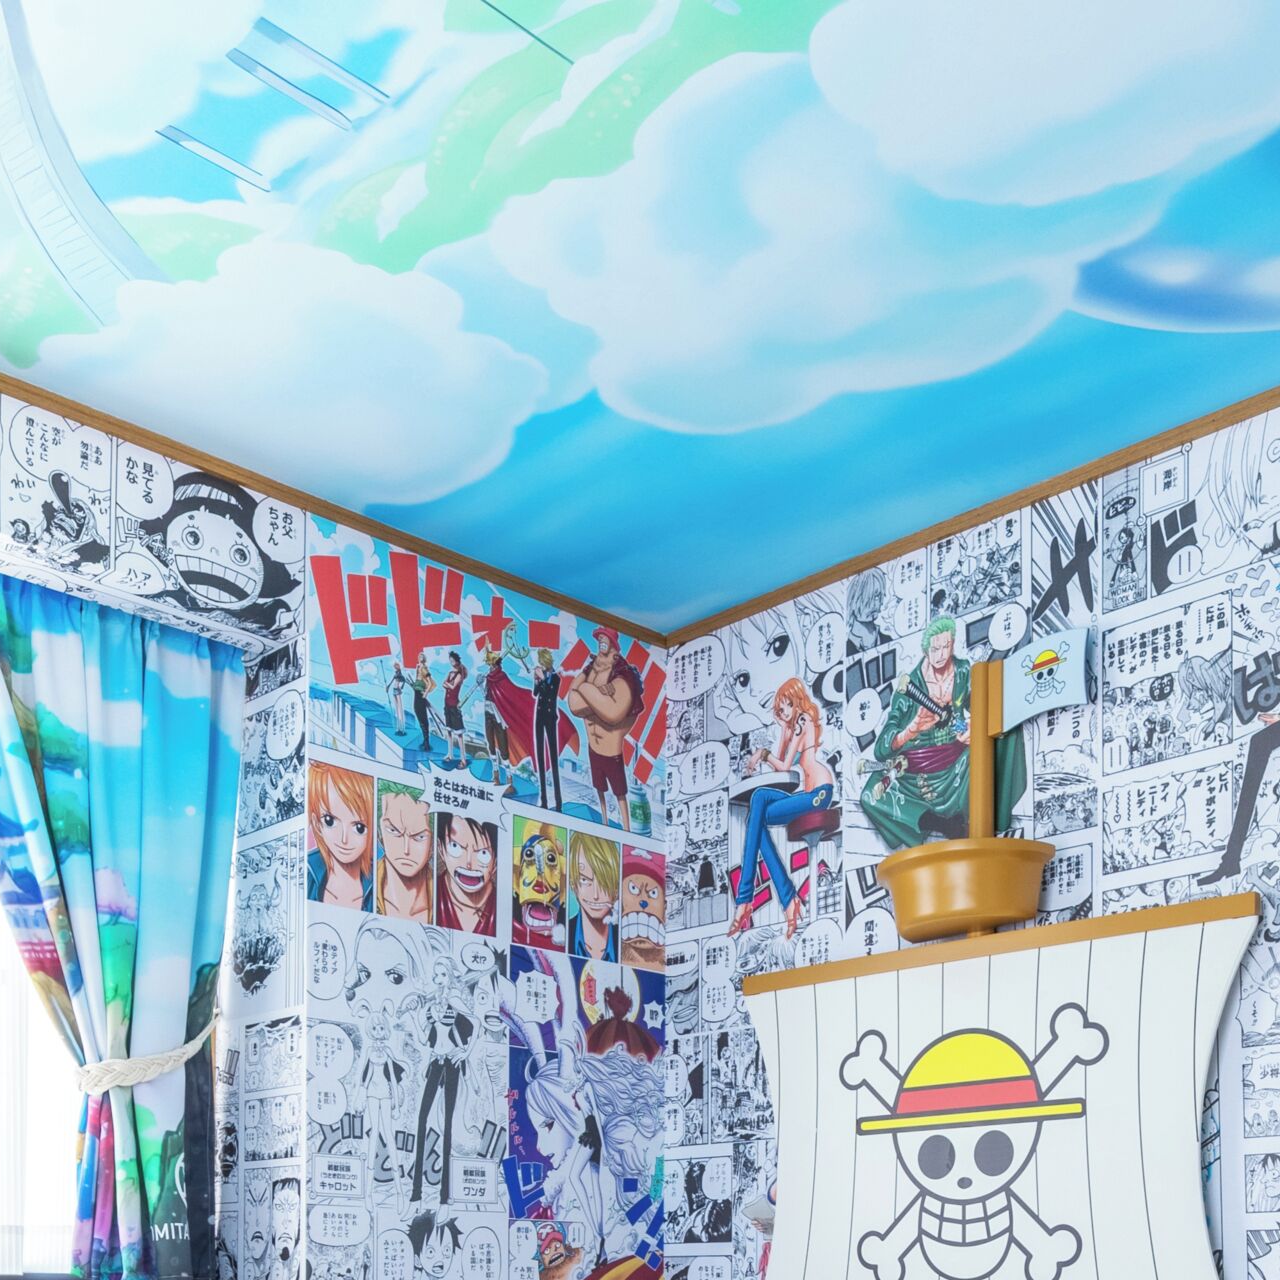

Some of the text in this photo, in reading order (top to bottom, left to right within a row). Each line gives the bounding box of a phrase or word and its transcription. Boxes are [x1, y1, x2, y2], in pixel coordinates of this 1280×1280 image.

[126, 456, 139, 485] かな
[140, 461, 154, 505] 見てる
[267, 506, 279, 547] ちゃん
[1135, 787, 1147, 819] レディ
[1148, 784, 1158, 816] ニード
[1205, 774, 1216, 839] シャボンディ
[319, 1180, 358, 1192] キャロット
[462, 1185, 487, 1198] ワンダ
